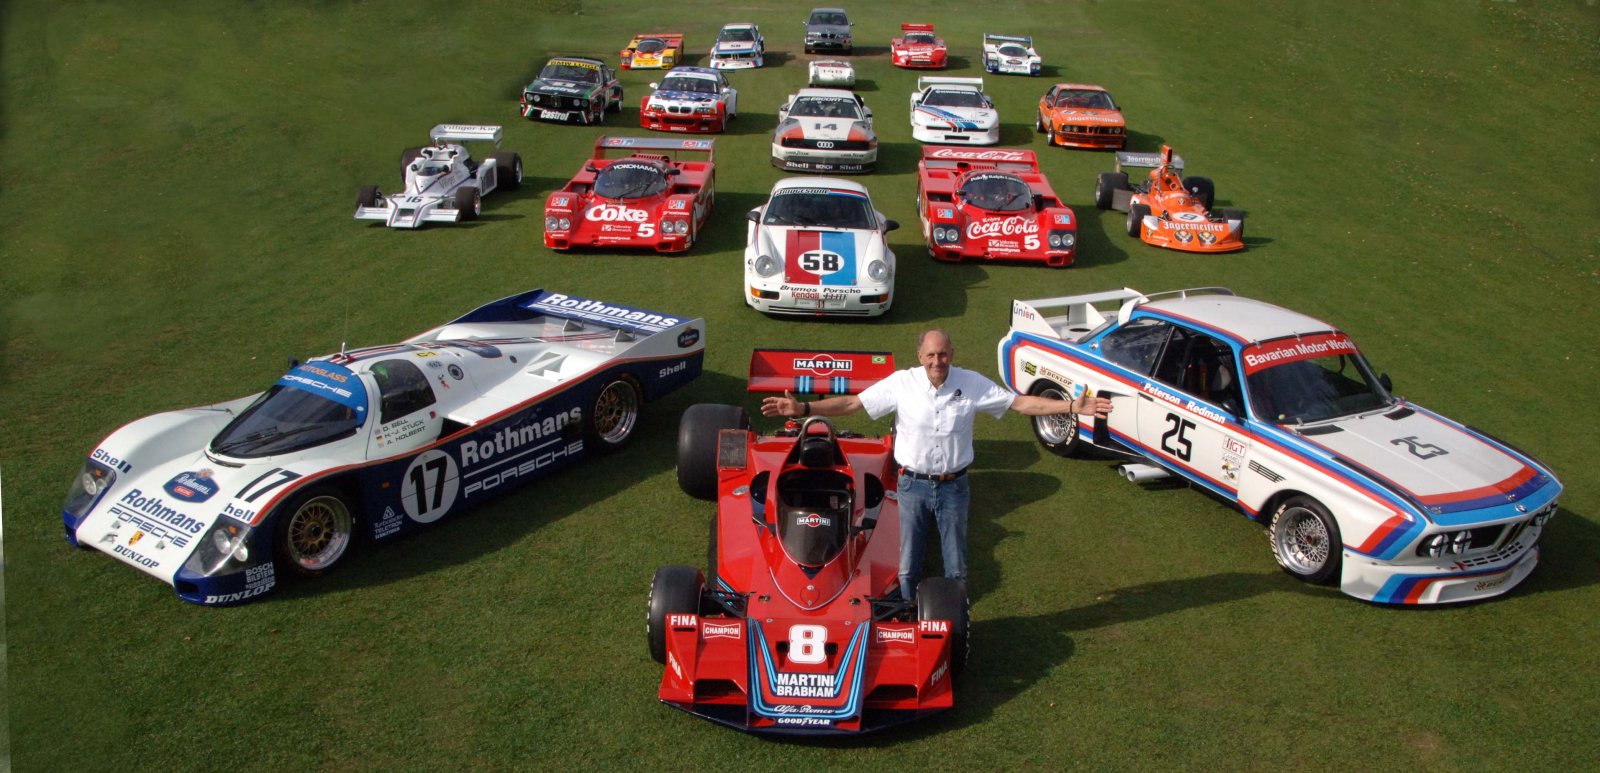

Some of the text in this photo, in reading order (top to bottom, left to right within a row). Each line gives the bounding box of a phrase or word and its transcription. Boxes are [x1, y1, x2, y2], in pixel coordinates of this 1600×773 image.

[540, 109, 570, 121] Castrol
[815, 123, 838, 131] 14
[931, 148, 1025, 162] Coca-Cola
[613, 163, 658, 174] YOKOHAMA
[785, 161, 809, 169] Shell
[585, 203, 648, 222] Coke
[637, 223, 655, 238] 5
[966, 216, 1039, 240] Coca-Cola
[1024, 234, 1041, 250] 5
[803, 253, 839, 271] 58
[780, 285, 818, 293] Brumos
[791, 292, 820, 300] Kendall
[527, 303, 664, 333] PORSCHE
[541, 293, 679, 328] Rothmans
[1013, 303, 1035, 321] union
[1244, 347, 1298, 367] Bavarian
[1295, 342, 1328, 355] Motor
[658, 360, 686, 379] Shell
[796, 360, 850, 369] MARTINI
[298, 364, 349, 384] AUTOGLASS
[1046, 371, 1073, 386] DUNLOP
[1143, 382, 1227, 425] Peterson Redman
[391, 419, 409, 428] BELL
[401, 419, 425, 433] STUCK
[386, 426, 426, 446] A. HOLBERT
[460, 406, 582, 468] Rothmans
[1161, 412, 1197, 463] 25
[1390, 435, 1450, 460] 25
[92, 447, 132, 474] Shell
[463, 439, 583, 499] PORSCHE
[234, 466, 303, 502] 17
[409, 455, 448, 516] 17
[120, 488, 206, 534] Rothmans
[106, 505, 191, 548] PORSCHE
[113, 544, 160, 569] DUNLOP
[245, 561, 274, 577] BOSCH
[246, 568, 275, 583] BILSTEIN
[204, 581, 276, 604] DUNLOP
[670, 615, 697, 626] FINA
[921, 621, 948, 632] FINA
[704, 626, 739, 635] CHAMPION
[878, 631, 913, 640] CHAMPION
[789, 623, 828, 665] 8
[669, 651, 683, 680] FINA
[931, 660, 948, 687] FINA
[777, 673, 834, 687] MARTINI
[776, 685, 834, 698] BRABHAM
[773, 704, 834, 715] Alfa Romeo
[777, 717, 831, 726] GOODYEAR
